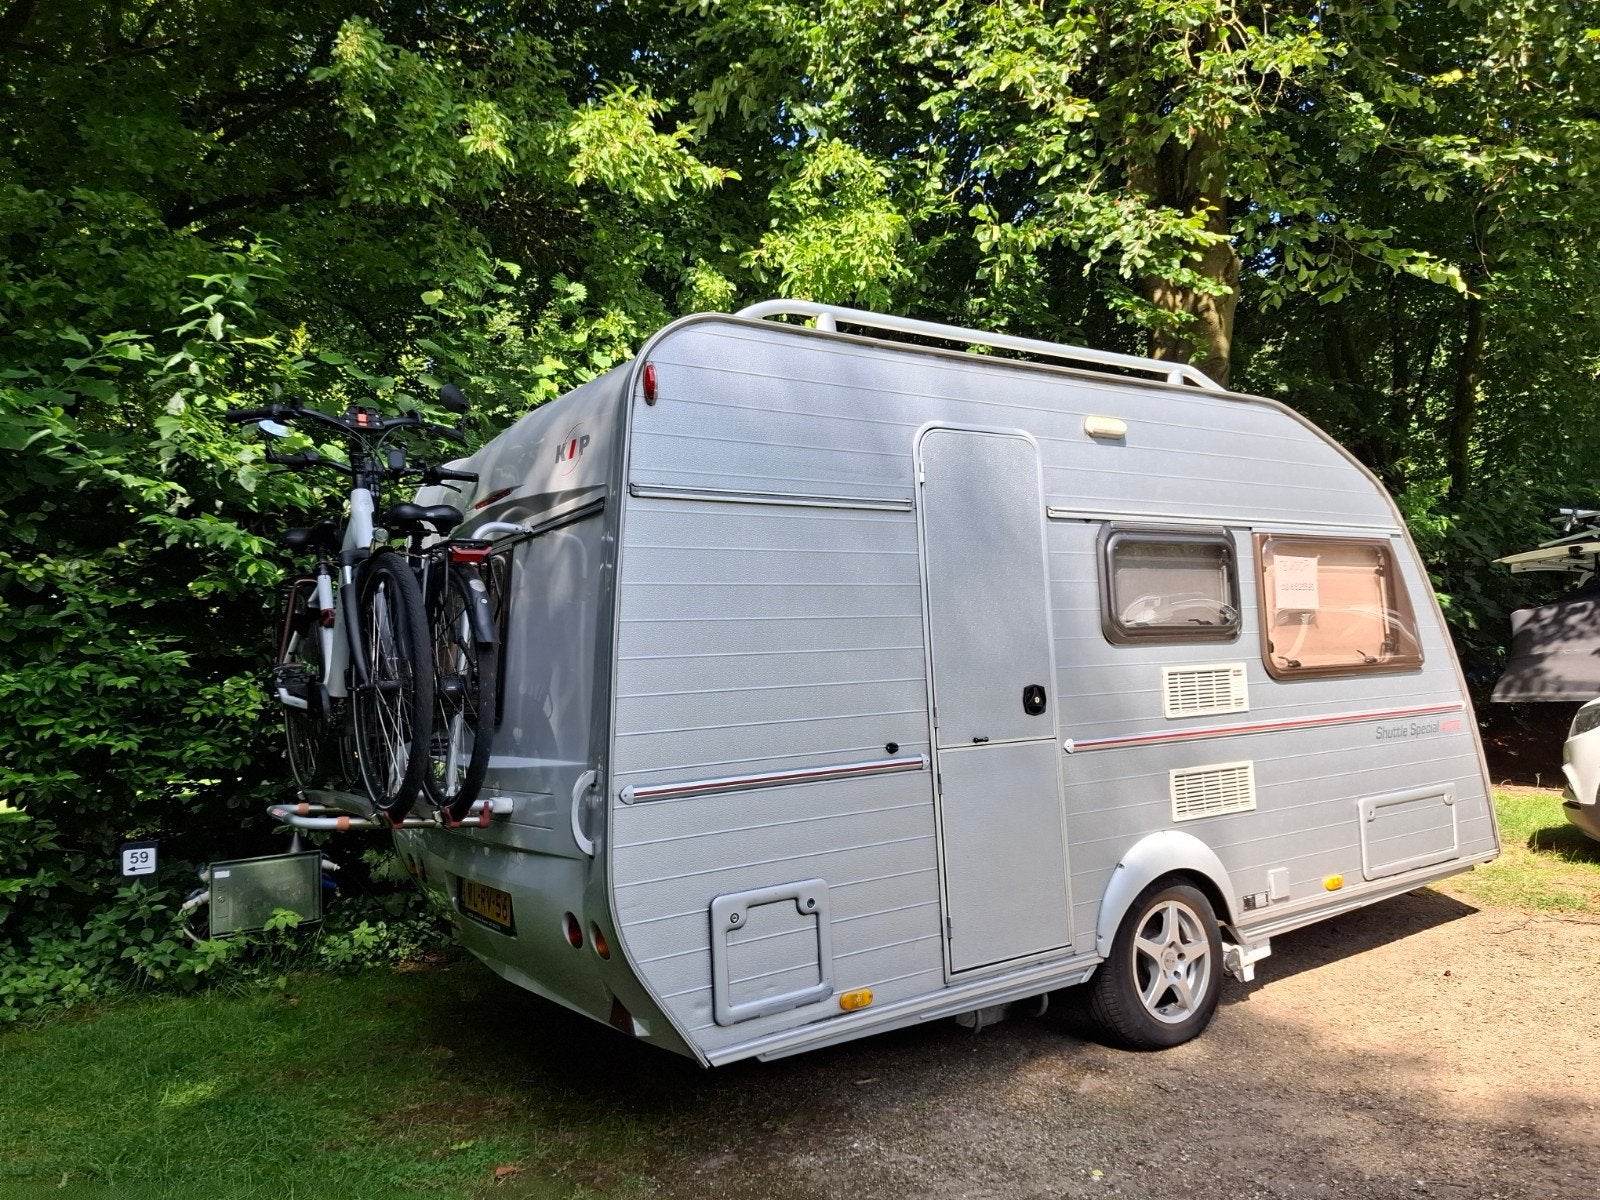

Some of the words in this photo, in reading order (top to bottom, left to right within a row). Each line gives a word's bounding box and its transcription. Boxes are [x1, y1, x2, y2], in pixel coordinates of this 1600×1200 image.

[555, 434, 591, 465] KIP
[1376, 725, 1409, 740] Shuttle
[1410, 720, 1440, 739] Special
[130, 851, 149, 865] 59
